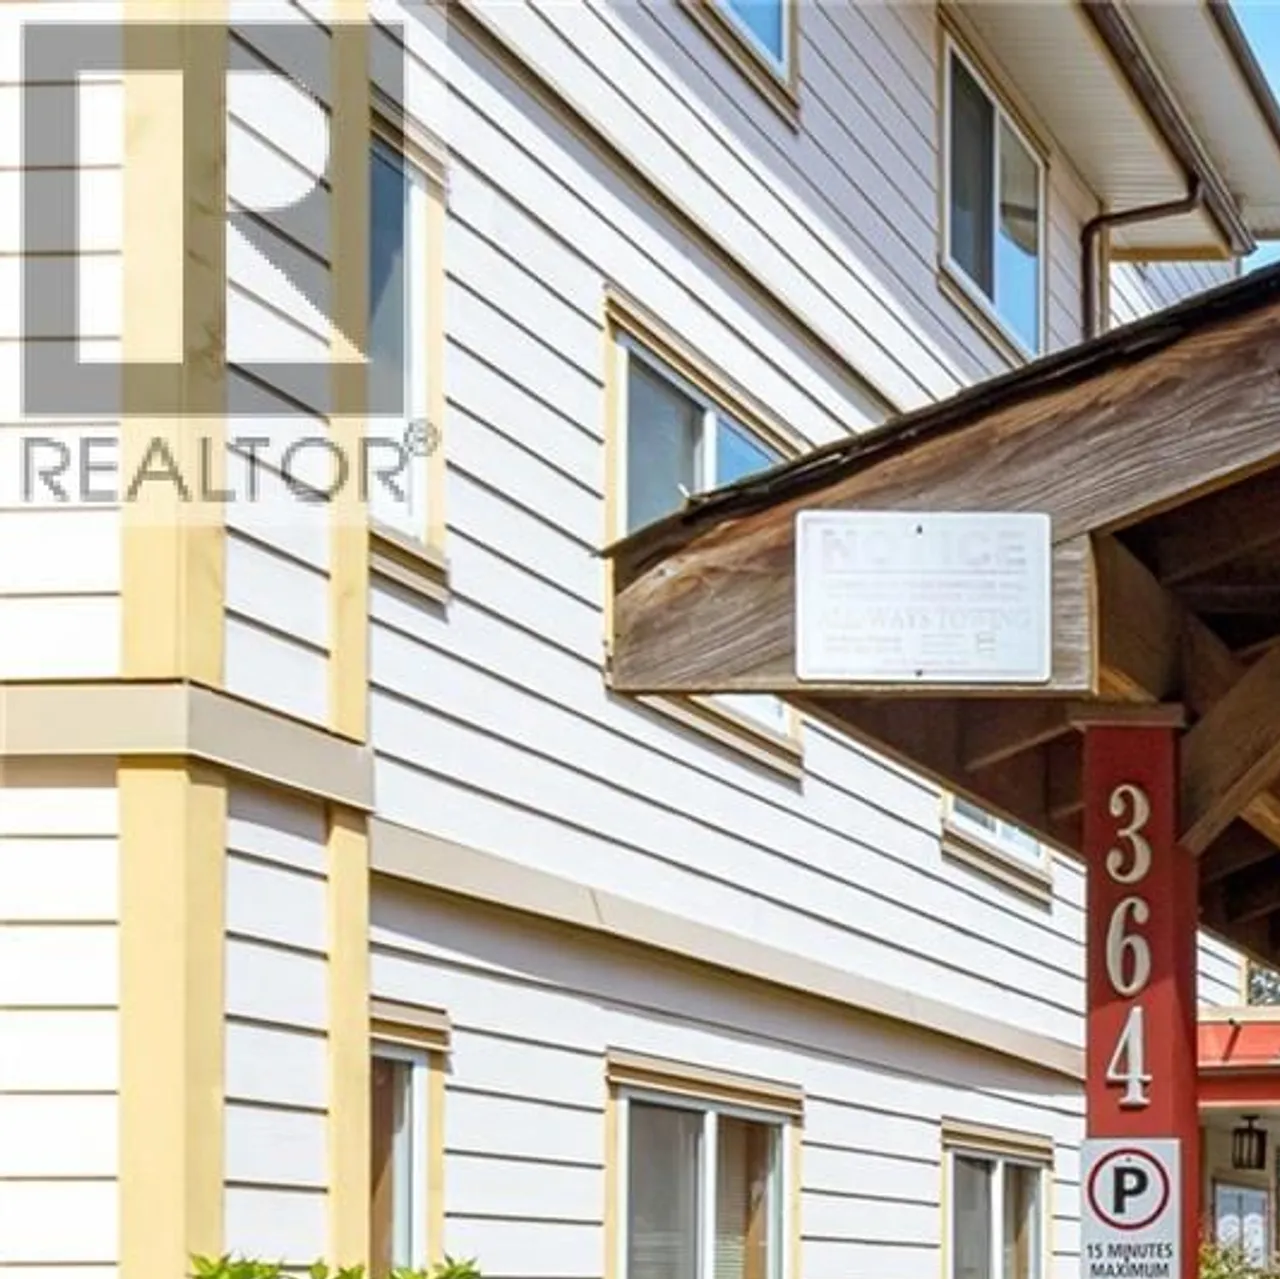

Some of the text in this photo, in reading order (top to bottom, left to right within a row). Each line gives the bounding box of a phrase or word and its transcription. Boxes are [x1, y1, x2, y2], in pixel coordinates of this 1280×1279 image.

[1106, 783, 1153, 1110] 364
[1113, 1166, 1149, 1214] P
[1087, 1243, 1173, 1259] 15 MINUTES
[1090, 1263, 1170, 1278] MAXIMUM
